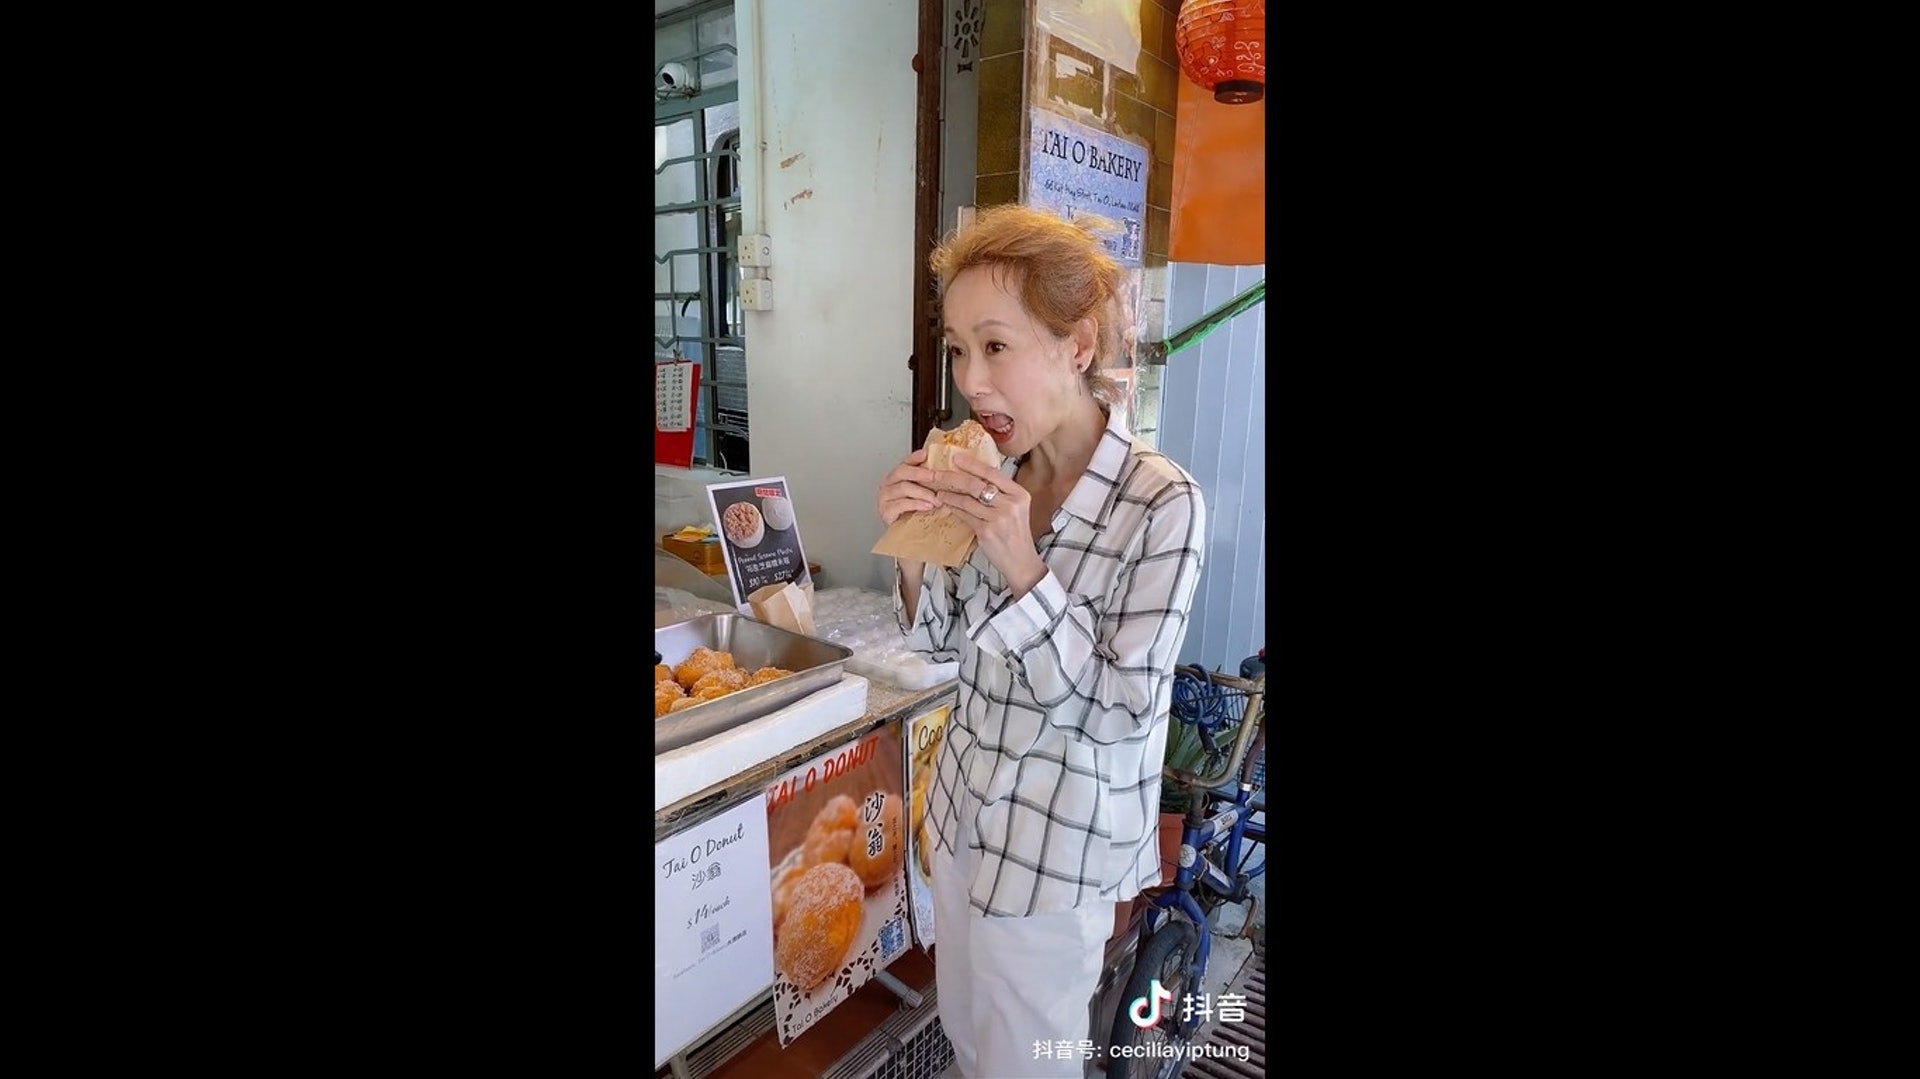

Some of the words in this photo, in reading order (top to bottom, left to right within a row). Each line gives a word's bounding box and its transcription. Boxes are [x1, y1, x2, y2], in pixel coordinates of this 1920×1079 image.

[1042, 130, 1068, 160] TAI
[1072, 141, 1086, 164] O
[1089, 145, 1142, 182] BAKERY
[767, 775, 797, 813] TAI
[805, 767, 816, 792] O
[823, 735, 879, 783] DONUT
[662, 858, 688, 879] Tai
[690, 845, 702, 864] O
[706, 822, 745, 857] Donut
[792, 1020, 804, 1033] Tai
[805, 1013, 812, 1023] O
[813, 994, 839, 1016] Bakery
